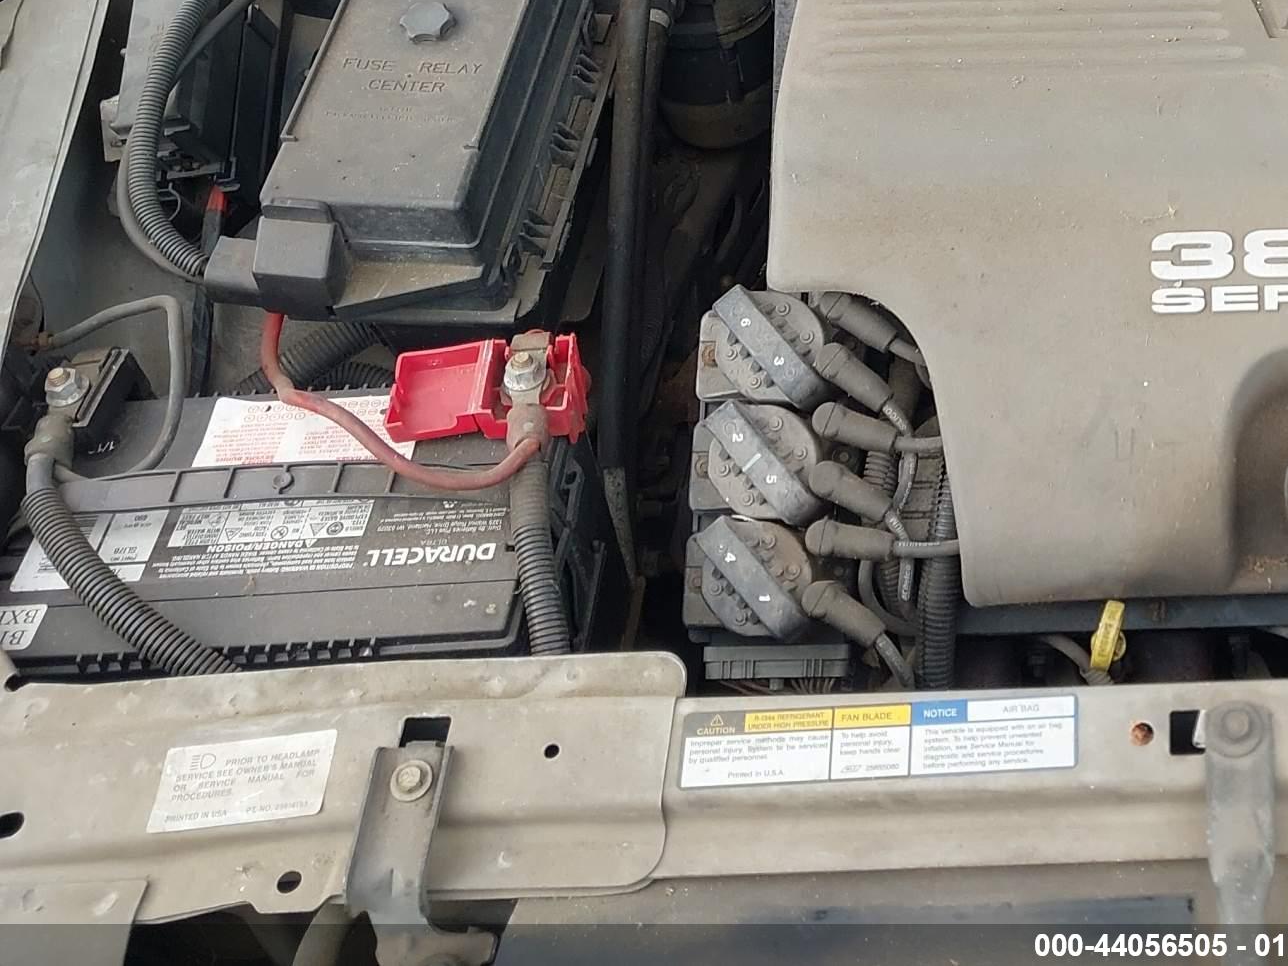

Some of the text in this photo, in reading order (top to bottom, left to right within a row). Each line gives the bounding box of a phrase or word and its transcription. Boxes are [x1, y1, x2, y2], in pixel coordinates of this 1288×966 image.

[342, 58, 483, 75] FUSE RELAY
[368, 79, 446, 93] CENTER
[774, 356, 785, 366] 3
[732, 433, 743, 443] 2
[766, 474, 777, 484] 5
[206, 540, 303, 553] DANGER/POISON
[365, 542, 497, 567] DURACELL
[724, 552, 736, 563] 4
[758, 593, 771, 602] 1
[923, 708, 957, 719] NOTICE
[1002, 704, 1040, 714] AIR BAG
[777, 711, 825, 720] REFRIGERANT
[841, 712, 892, 722] FAN BLADE
[748, 719, 829, 730] UNDER HIGH PRESSURE
[697, 726, 736, 736] CAUTION
[925, 728, 939, 736] This
[976, 725, 1008, 734] equipped
[963, 734, 977, 742] help
[980, 733, 1006, 741] prevent
[998, 740, 1023, 748] Manual
[689, 747, 720, 756] personal
[747, 745, 773, 753] System
[840, 748, 857, 756] keep
[923, 752, 959, 761] diagnostic
[1003, 748, 1043, 757] procedures
[225, 748, 321, 766] PRIOR TO HEADLAMP
[688, 756, 698, 764] by
[699, 755, 730, 764] qualified
[947, 759, 986, 768] performing
[176, 759, 317, 783] SERVICE SEE OWNER'S MANUAL
[727, 771, 753, 779] Printed
[173, 769, 315, 792] OR SERVICE MANUAL FOR
[165, 812, 199, 823] PRINTED
[201, 811, 209, 819] IN
[211, 810, 227, 818] USA
